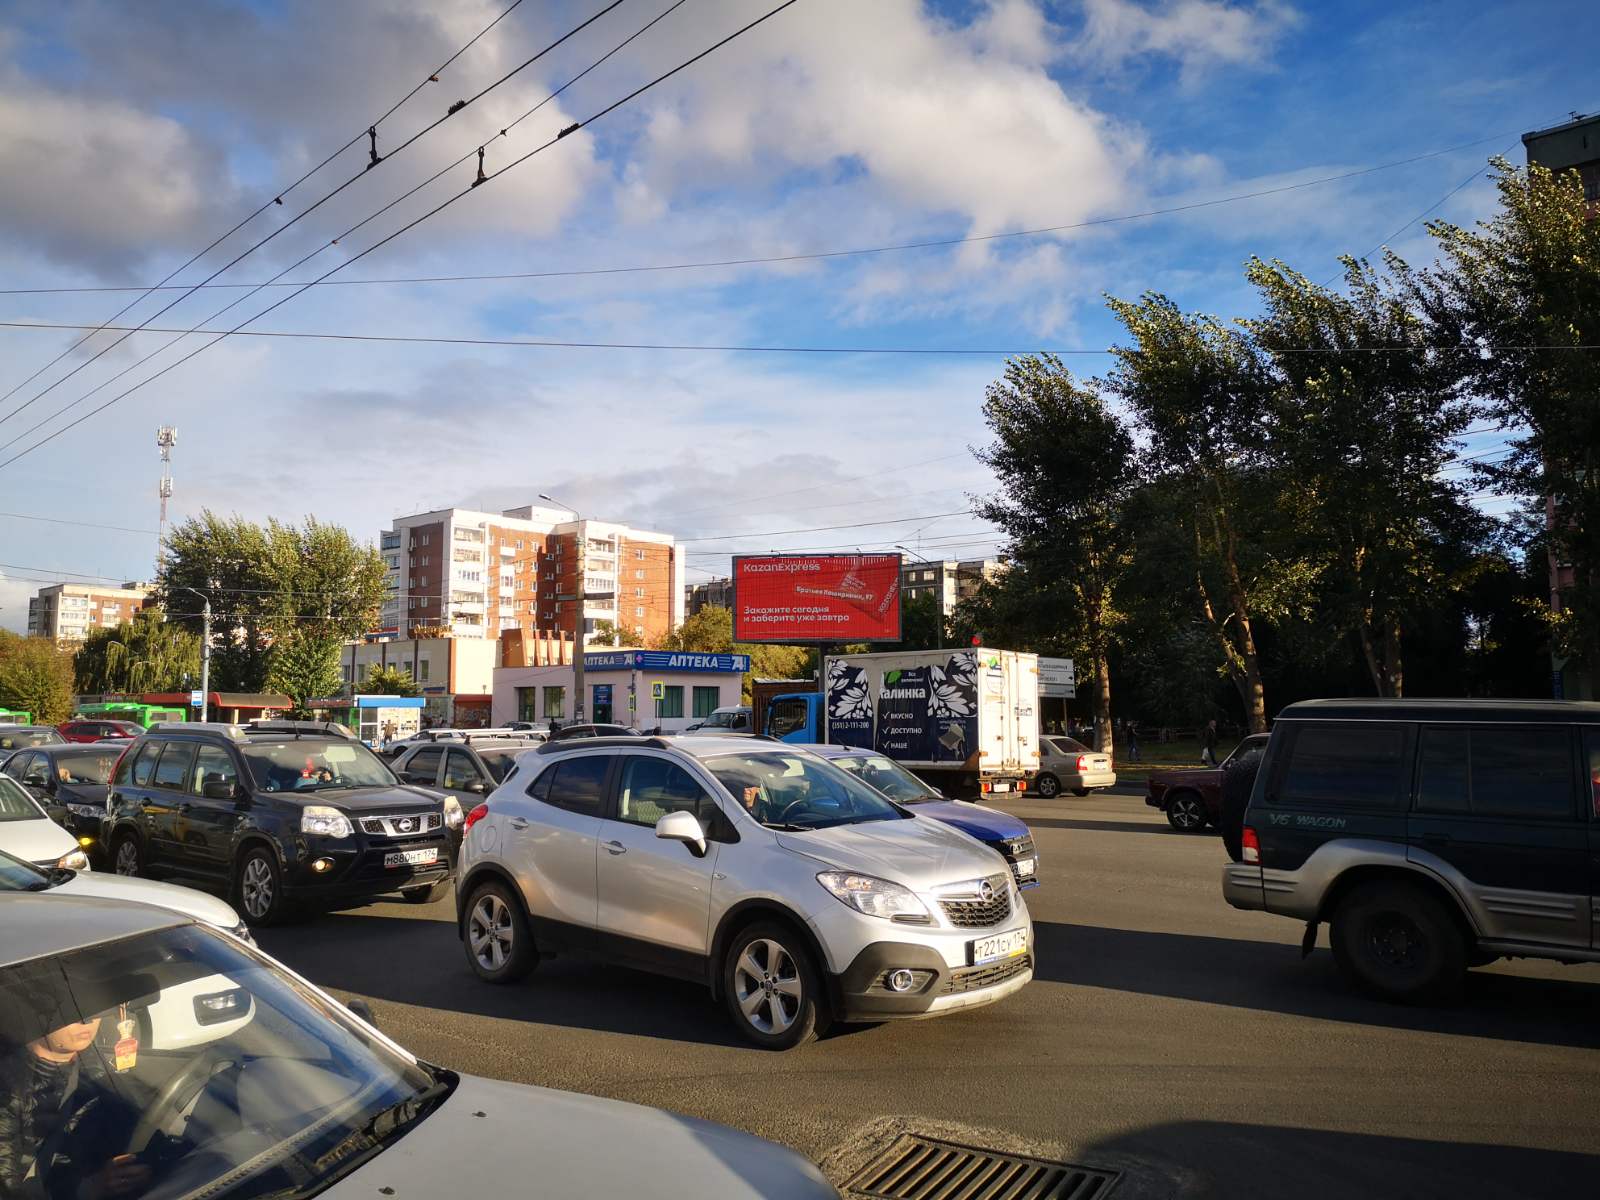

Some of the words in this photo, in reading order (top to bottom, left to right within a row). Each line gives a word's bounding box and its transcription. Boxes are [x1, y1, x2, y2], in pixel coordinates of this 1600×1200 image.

[743, 562, 821, 573] KazanExpress
[743, 605, 790, 615] Закажите
[792, 606, 829, 614] сегодня
[751, 614, 795, 624] заберите
[797, 615, 816, 623] уже
[817, 614, 850, 623] завтра
[584, 655, 615, 666] АПТЕКА
[668, 654, 718, 668] АПТЕКА
[890, 712, 914, 720] ВКУСНО
[890, 727, 923, 735] ДОСТУПНО
[1296, 815, 1347, 828] WAGON
